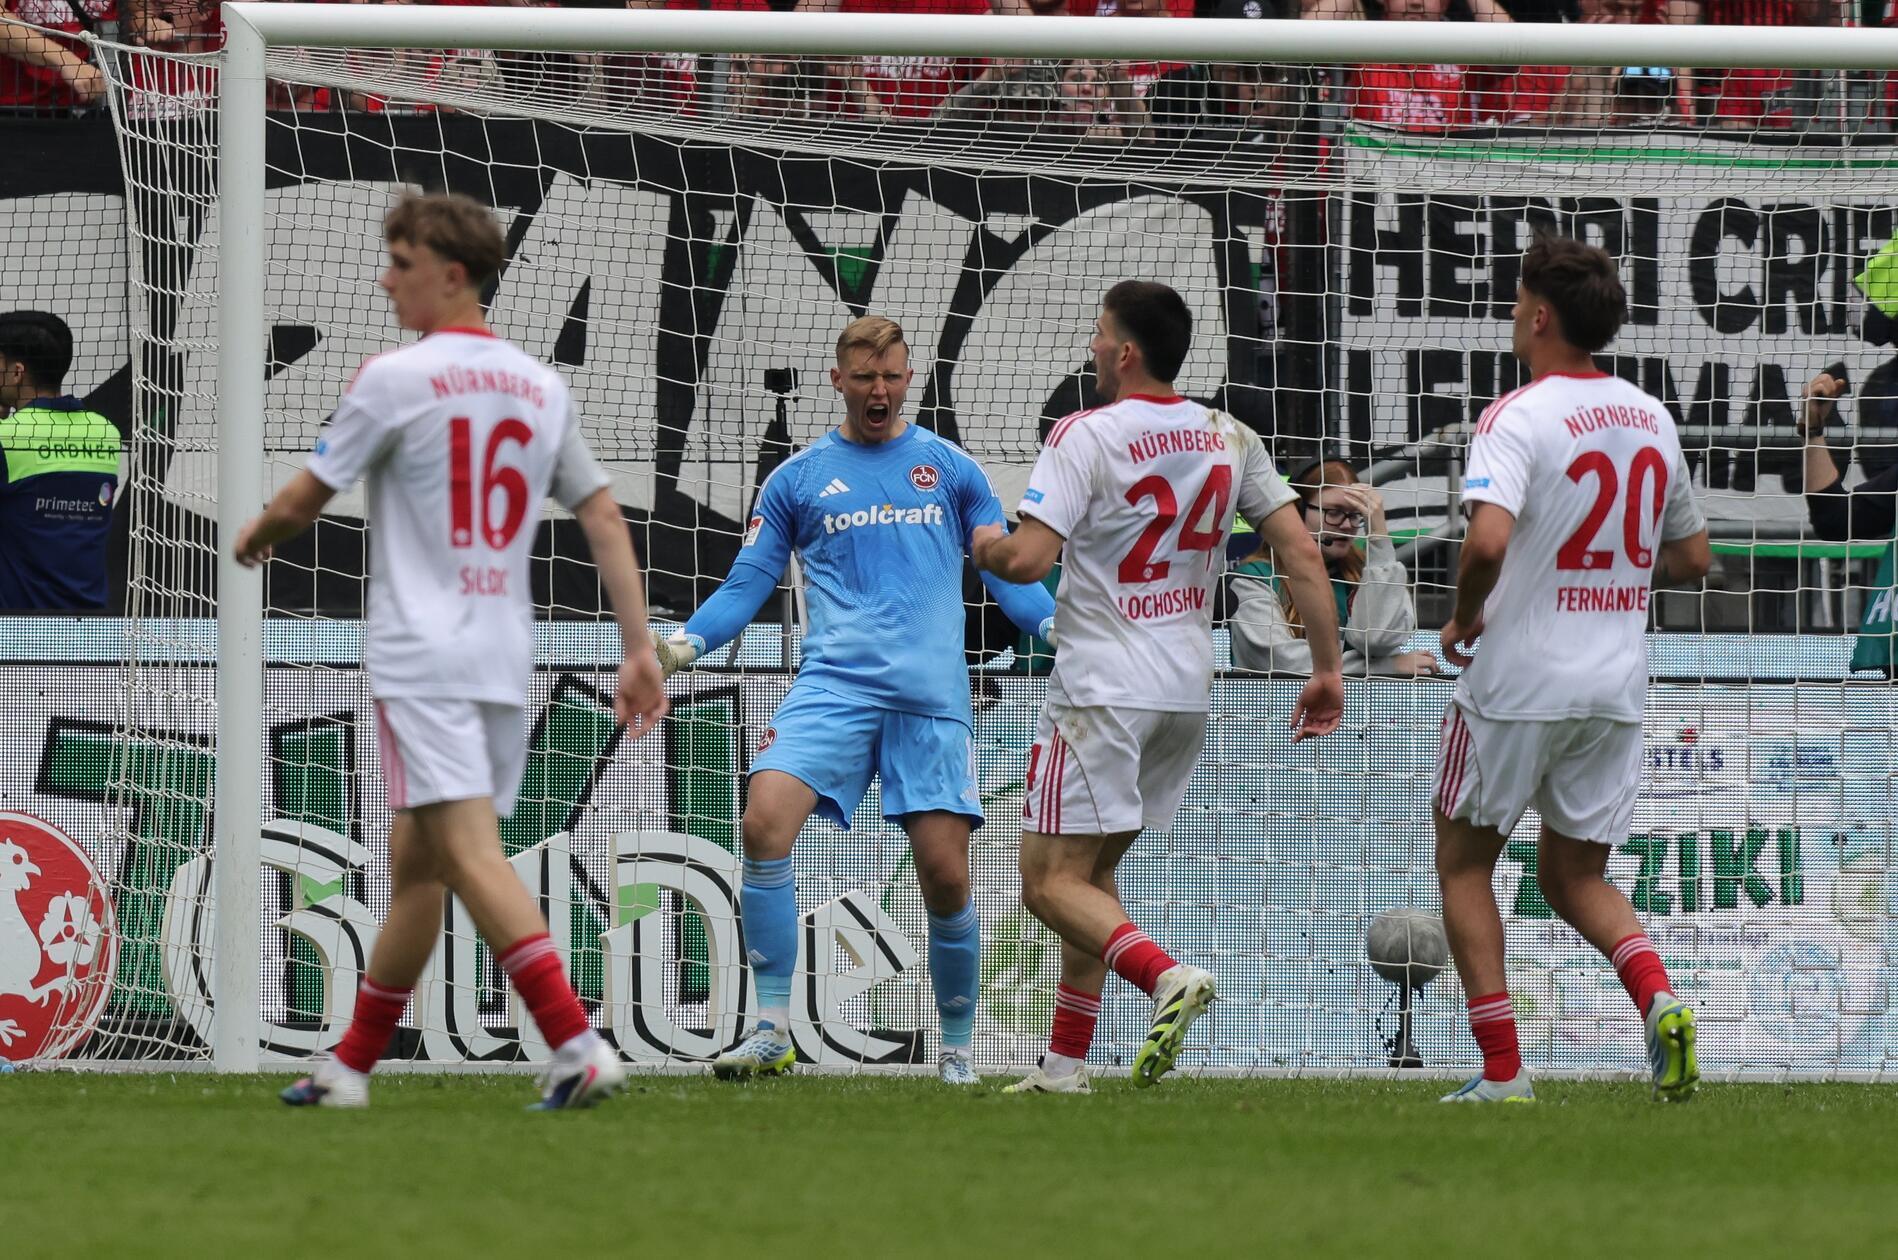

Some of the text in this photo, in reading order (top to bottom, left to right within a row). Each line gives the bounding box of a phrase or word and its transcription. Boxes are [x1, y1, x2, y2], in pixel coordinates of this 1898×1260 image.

[430, 366, 545, 409] NÜRNBERG
[1563, 405, 1659, 438] NÜRNBERG
[38, 444, 117, 460] ORDNER
[1128, 430, 1225, 465] NÜRNBERG
[449, 416, 534, 551] 16
[913, 473, 936, 482] FCN
[35, 496, 96, 512] primetec
[823, 503, 943, 535] toolcraft
[1556, 447, 1668, 570] 20
[1117, 464, 1233, 584] 24
